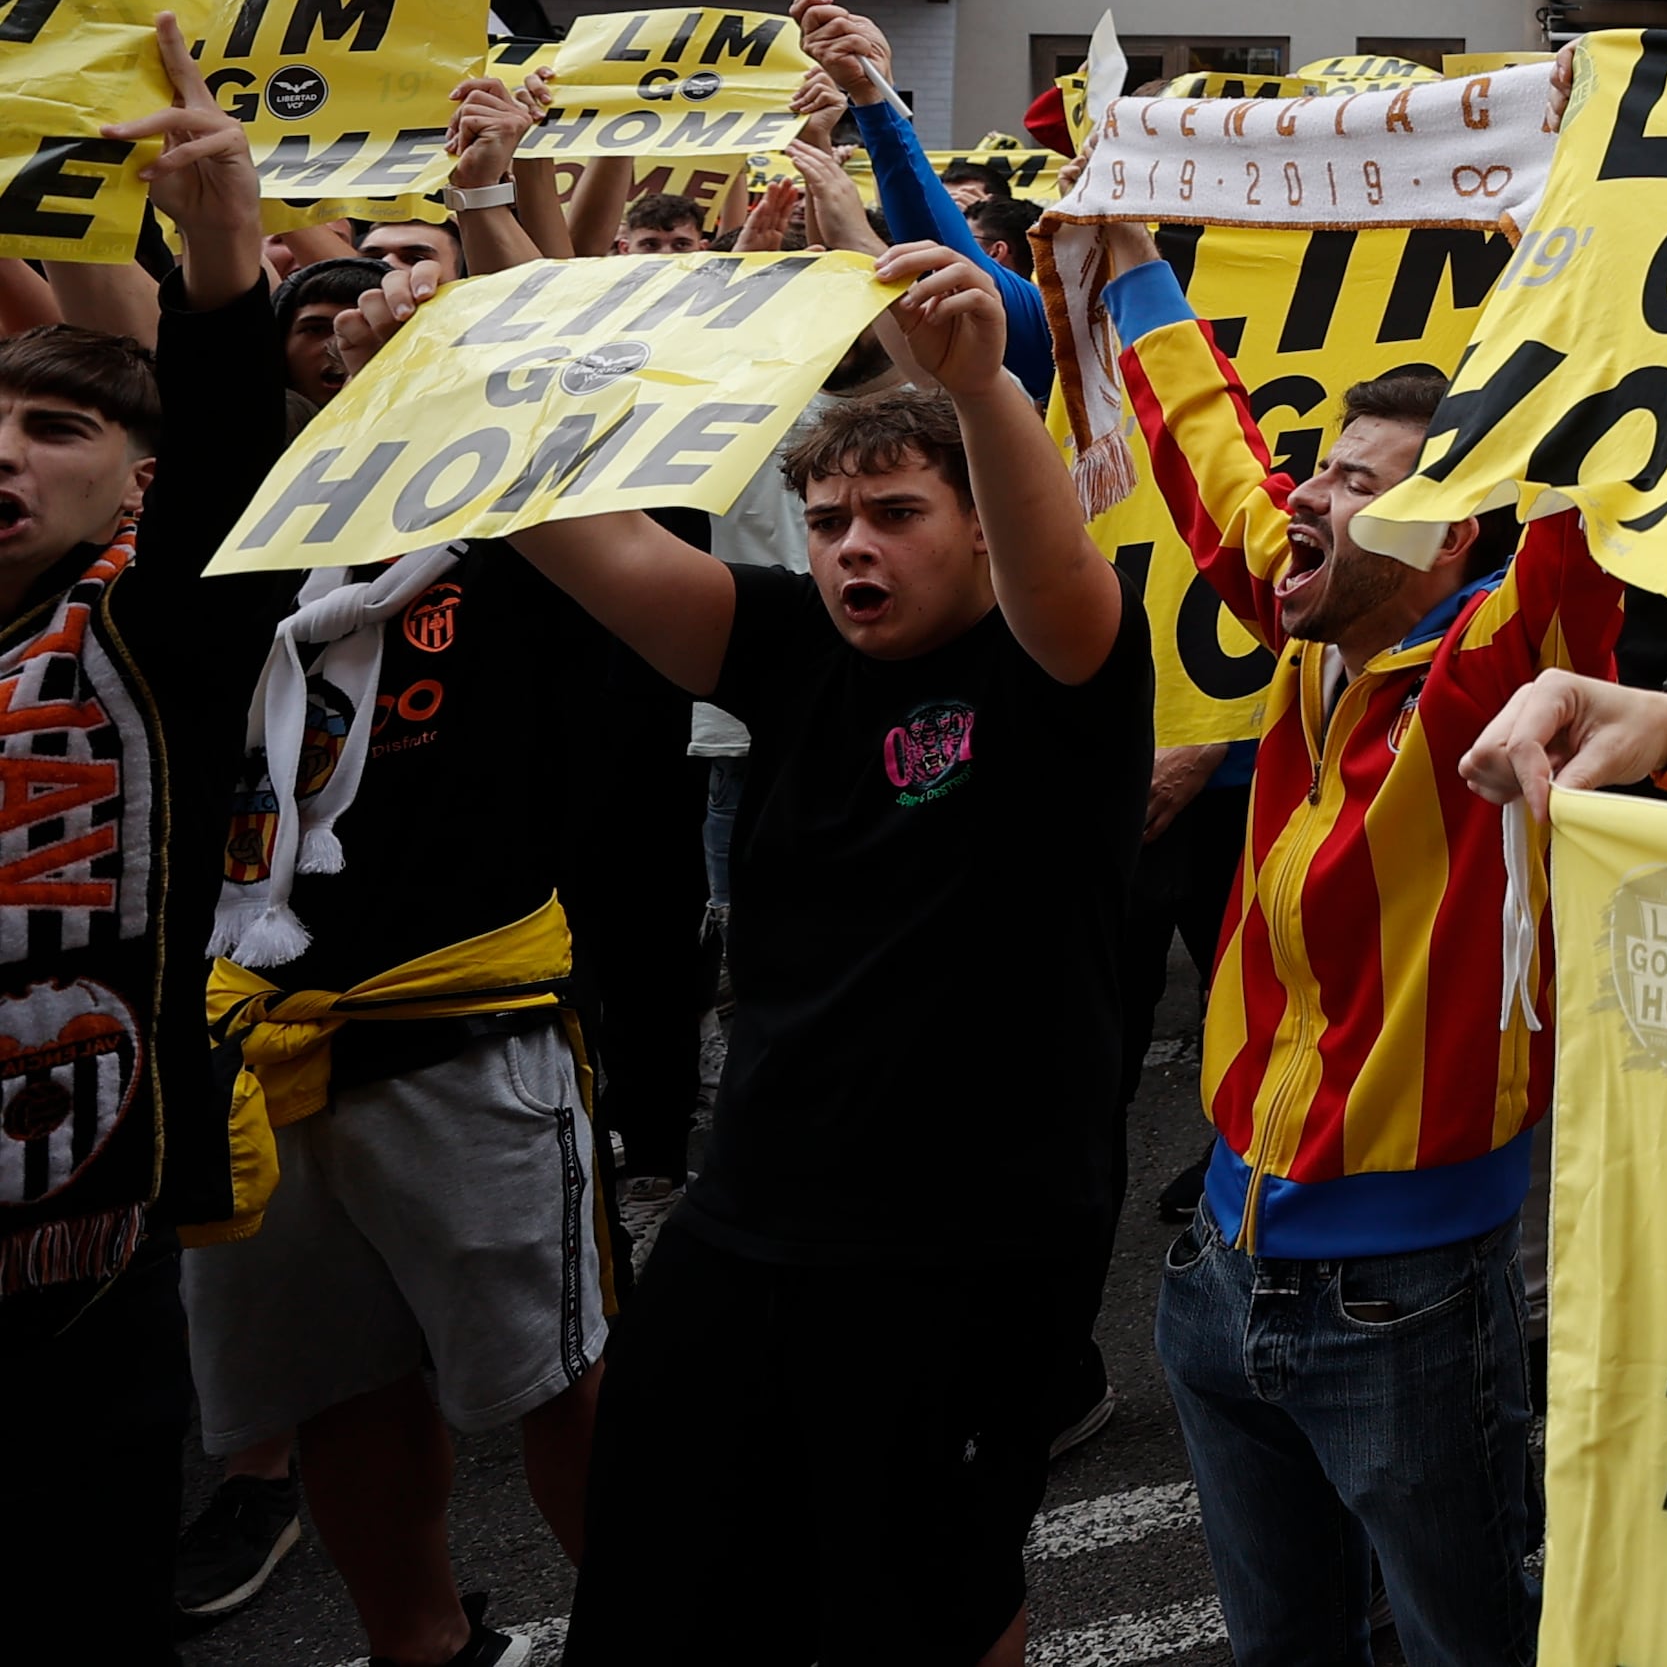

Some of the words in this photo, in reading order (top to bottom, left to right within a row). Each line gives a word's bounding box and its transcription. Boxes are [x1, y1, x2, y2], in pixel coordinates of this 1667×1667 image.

[603, 12, 788, 67] LIM
[1324, 58, 1417, 80] LIM
[276, 94, 317, 104] LIBERTAD
[287, 102, 304, 110] VCF
[522, 108, 805, 149] HOME
[258, 127, 449, 187] ME
[453, 256, 819, 348] LIM
[236, 403, 777, 550] HOME
[562, 1126, 574, 1173] TOMMY
[569, 1183, 580, 1238] HILFIGER
[567, 1254, 577, 1305] TOMMY
[566, 1316, 581, 1371] HILFIGER
